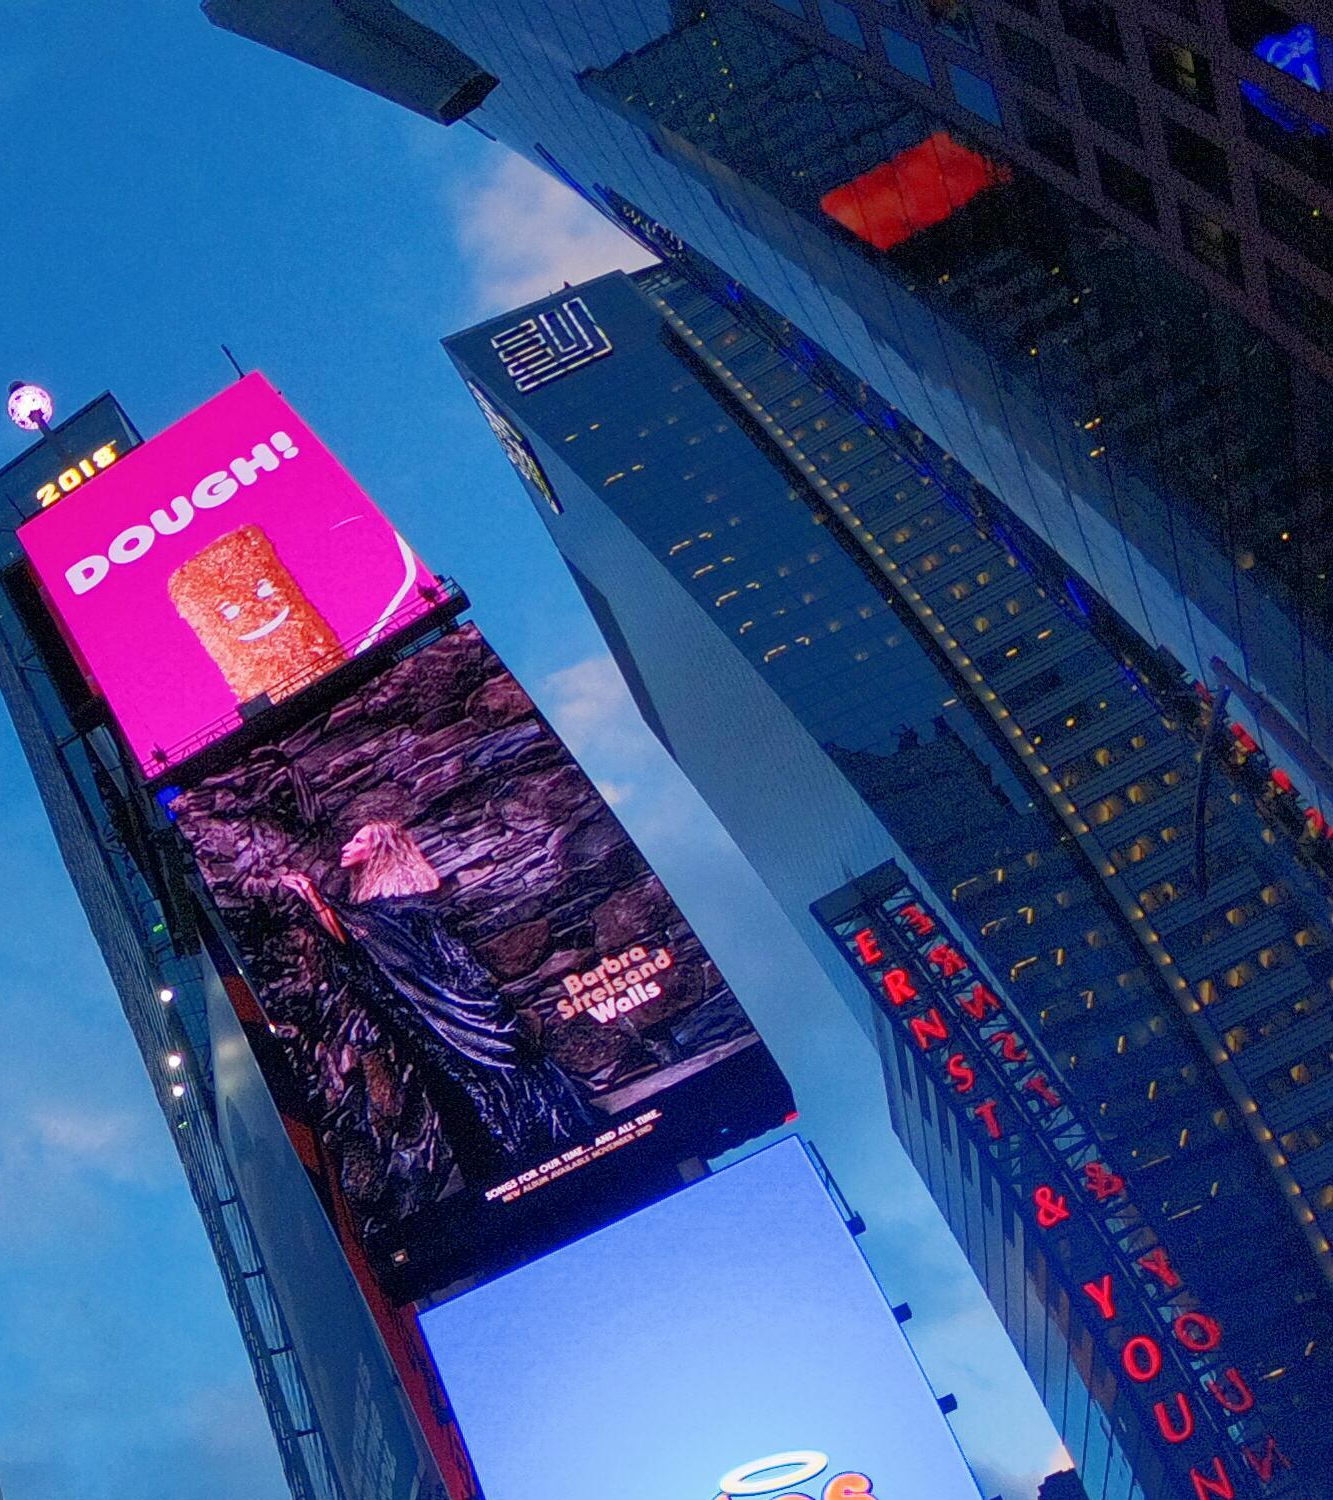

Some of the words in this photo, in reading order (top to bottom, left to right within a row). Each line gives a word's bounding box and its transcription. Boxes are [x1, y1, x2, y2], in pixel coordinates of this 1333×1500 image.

[36, 440, 118, 508] 2018
[64, 430, 299, 596] DOUGH!
[556, 948, 672, 1021] Streisand
[561, 946, 647, 997] Barbra
[586, 981, 661, 1024] Walls
[853, 925, 1004, 1140] ERNST
[1033, 1184, 1070, 1230] &
[485, 1178, 518, 1201] SONGS
[517, 1168, 539, 1185] FOR
[538, 1157, 562, 1174] OUR
[594, 1130, 616, 1147] AND
[617, 1121, 636, 1135] ALL
